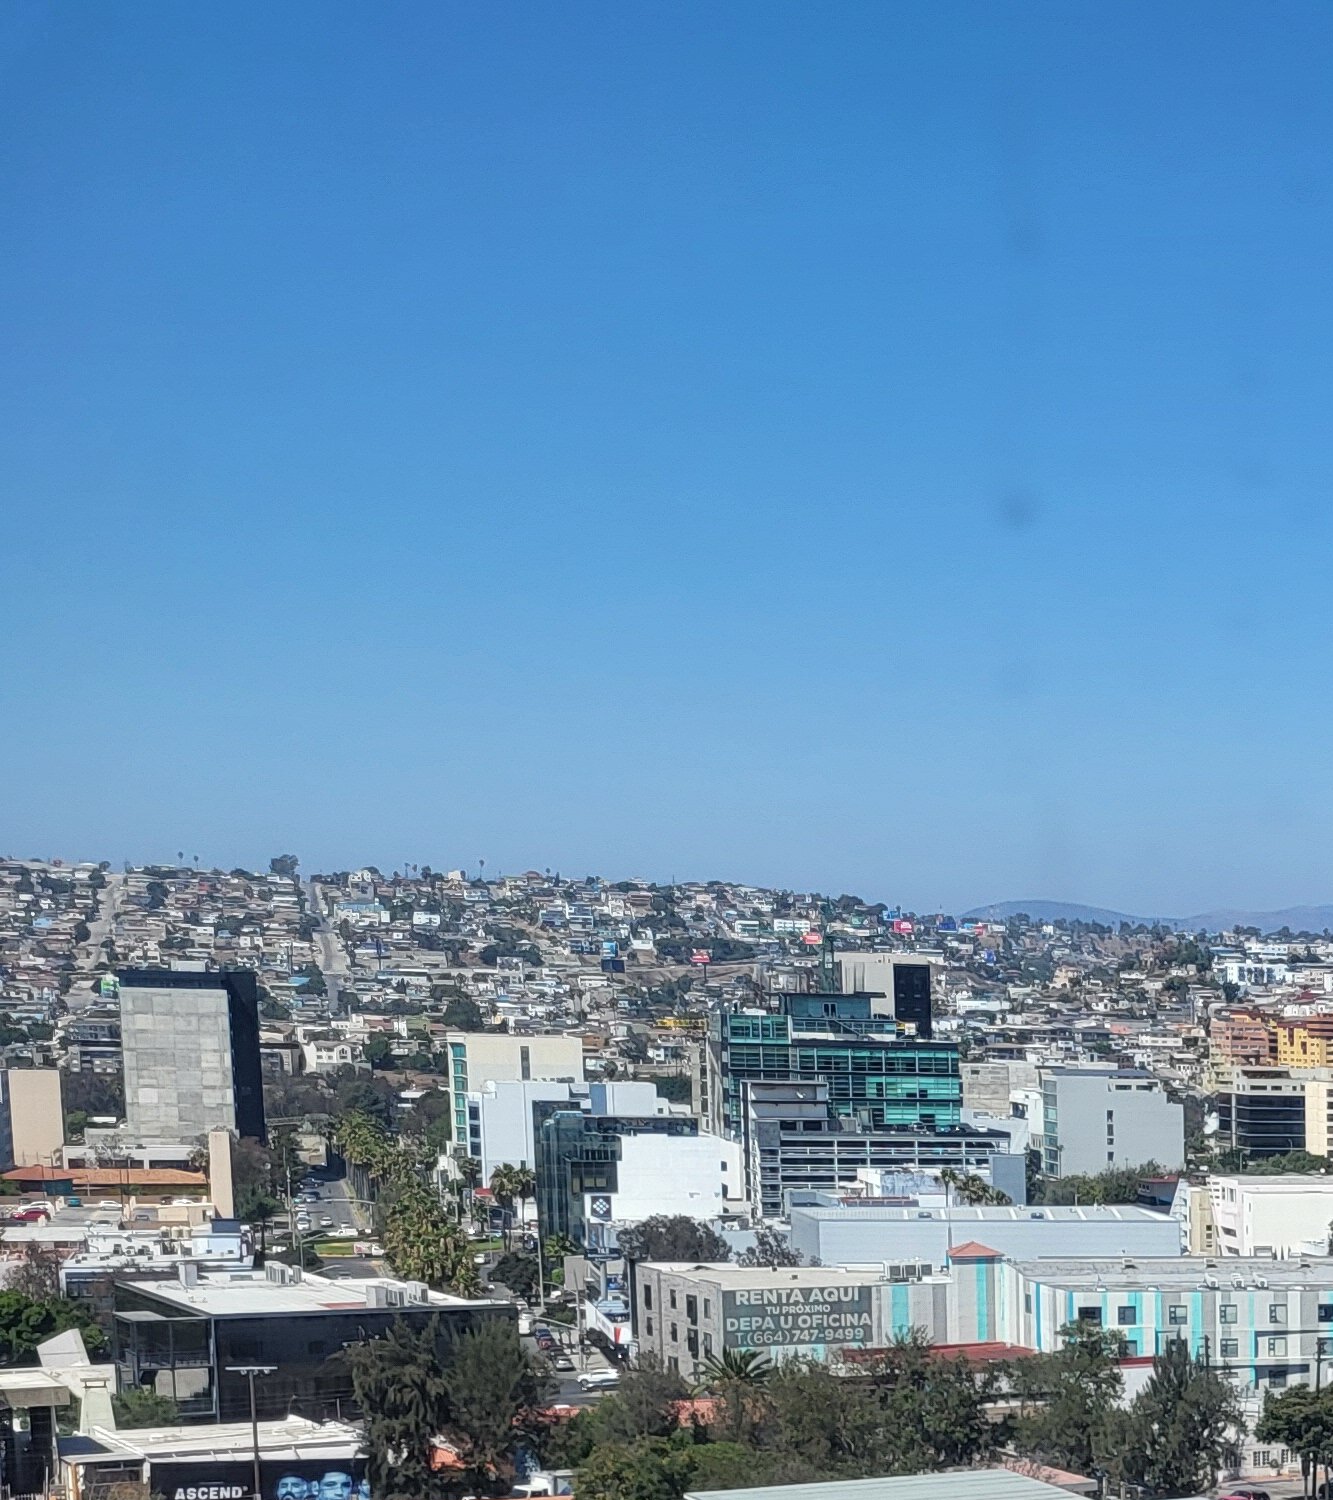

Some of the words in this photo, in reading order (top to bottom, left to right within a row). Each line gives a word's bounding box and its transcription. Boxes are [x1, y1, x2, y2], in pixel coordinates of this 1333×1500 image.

[735, 1289, 805, 1306] RENTA
[809, 1286, 860, 1302] AQUI
[766, 1306, 780, 1315] TU
[726, 1317, 775, 1332] DEPA
[780, 1316, 793, 1329] U
[797, 1313, 872, 1328] OFICINA
